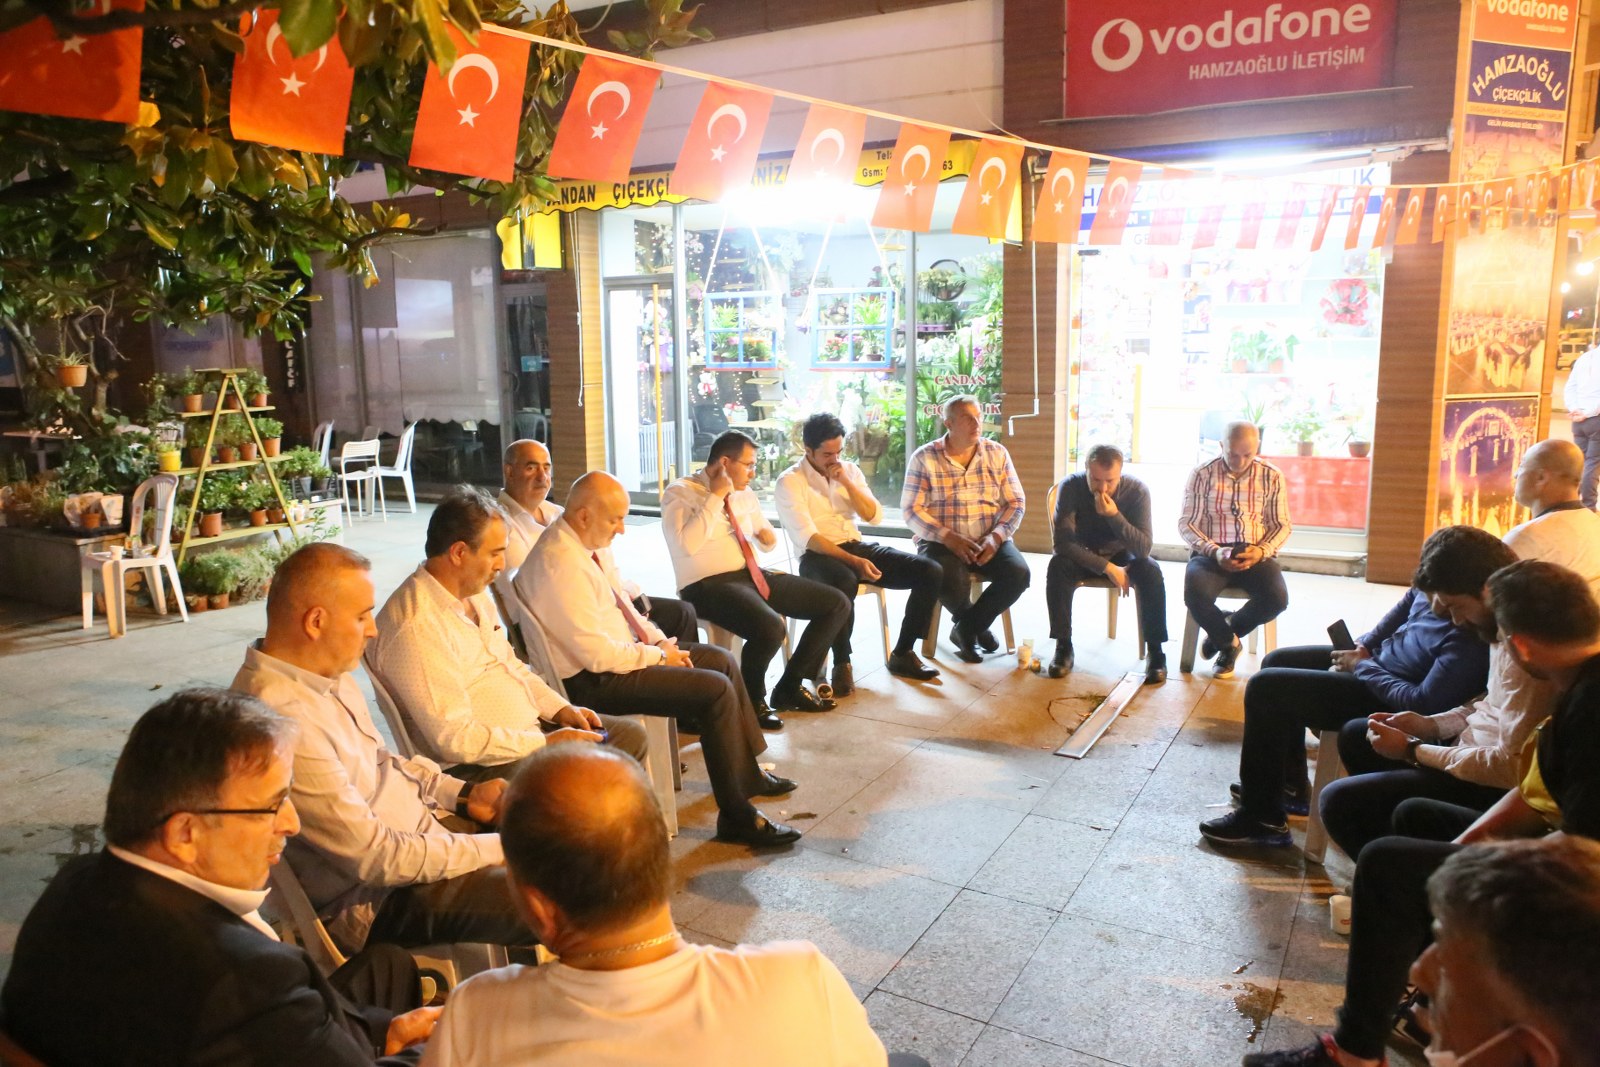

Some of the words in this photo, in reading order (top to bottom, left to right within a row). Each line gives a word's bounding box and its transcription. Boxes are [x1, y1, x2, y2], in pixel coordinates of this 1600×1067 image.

[1149, 3, 1371, 54] vodafone
[1189, 55, 1287, 80] HAMZAOĞLU
[1292, 45, 1365, 71] İLETİŞİM
[1472, 54, 1565, 101] HAMZAOĞLU
[1492, 86, 1542, 104] ÇİÇEKÇİLİK
[862, 167, 883, 178] Gsm:
[934, 374, 987, 386] CANDAN
